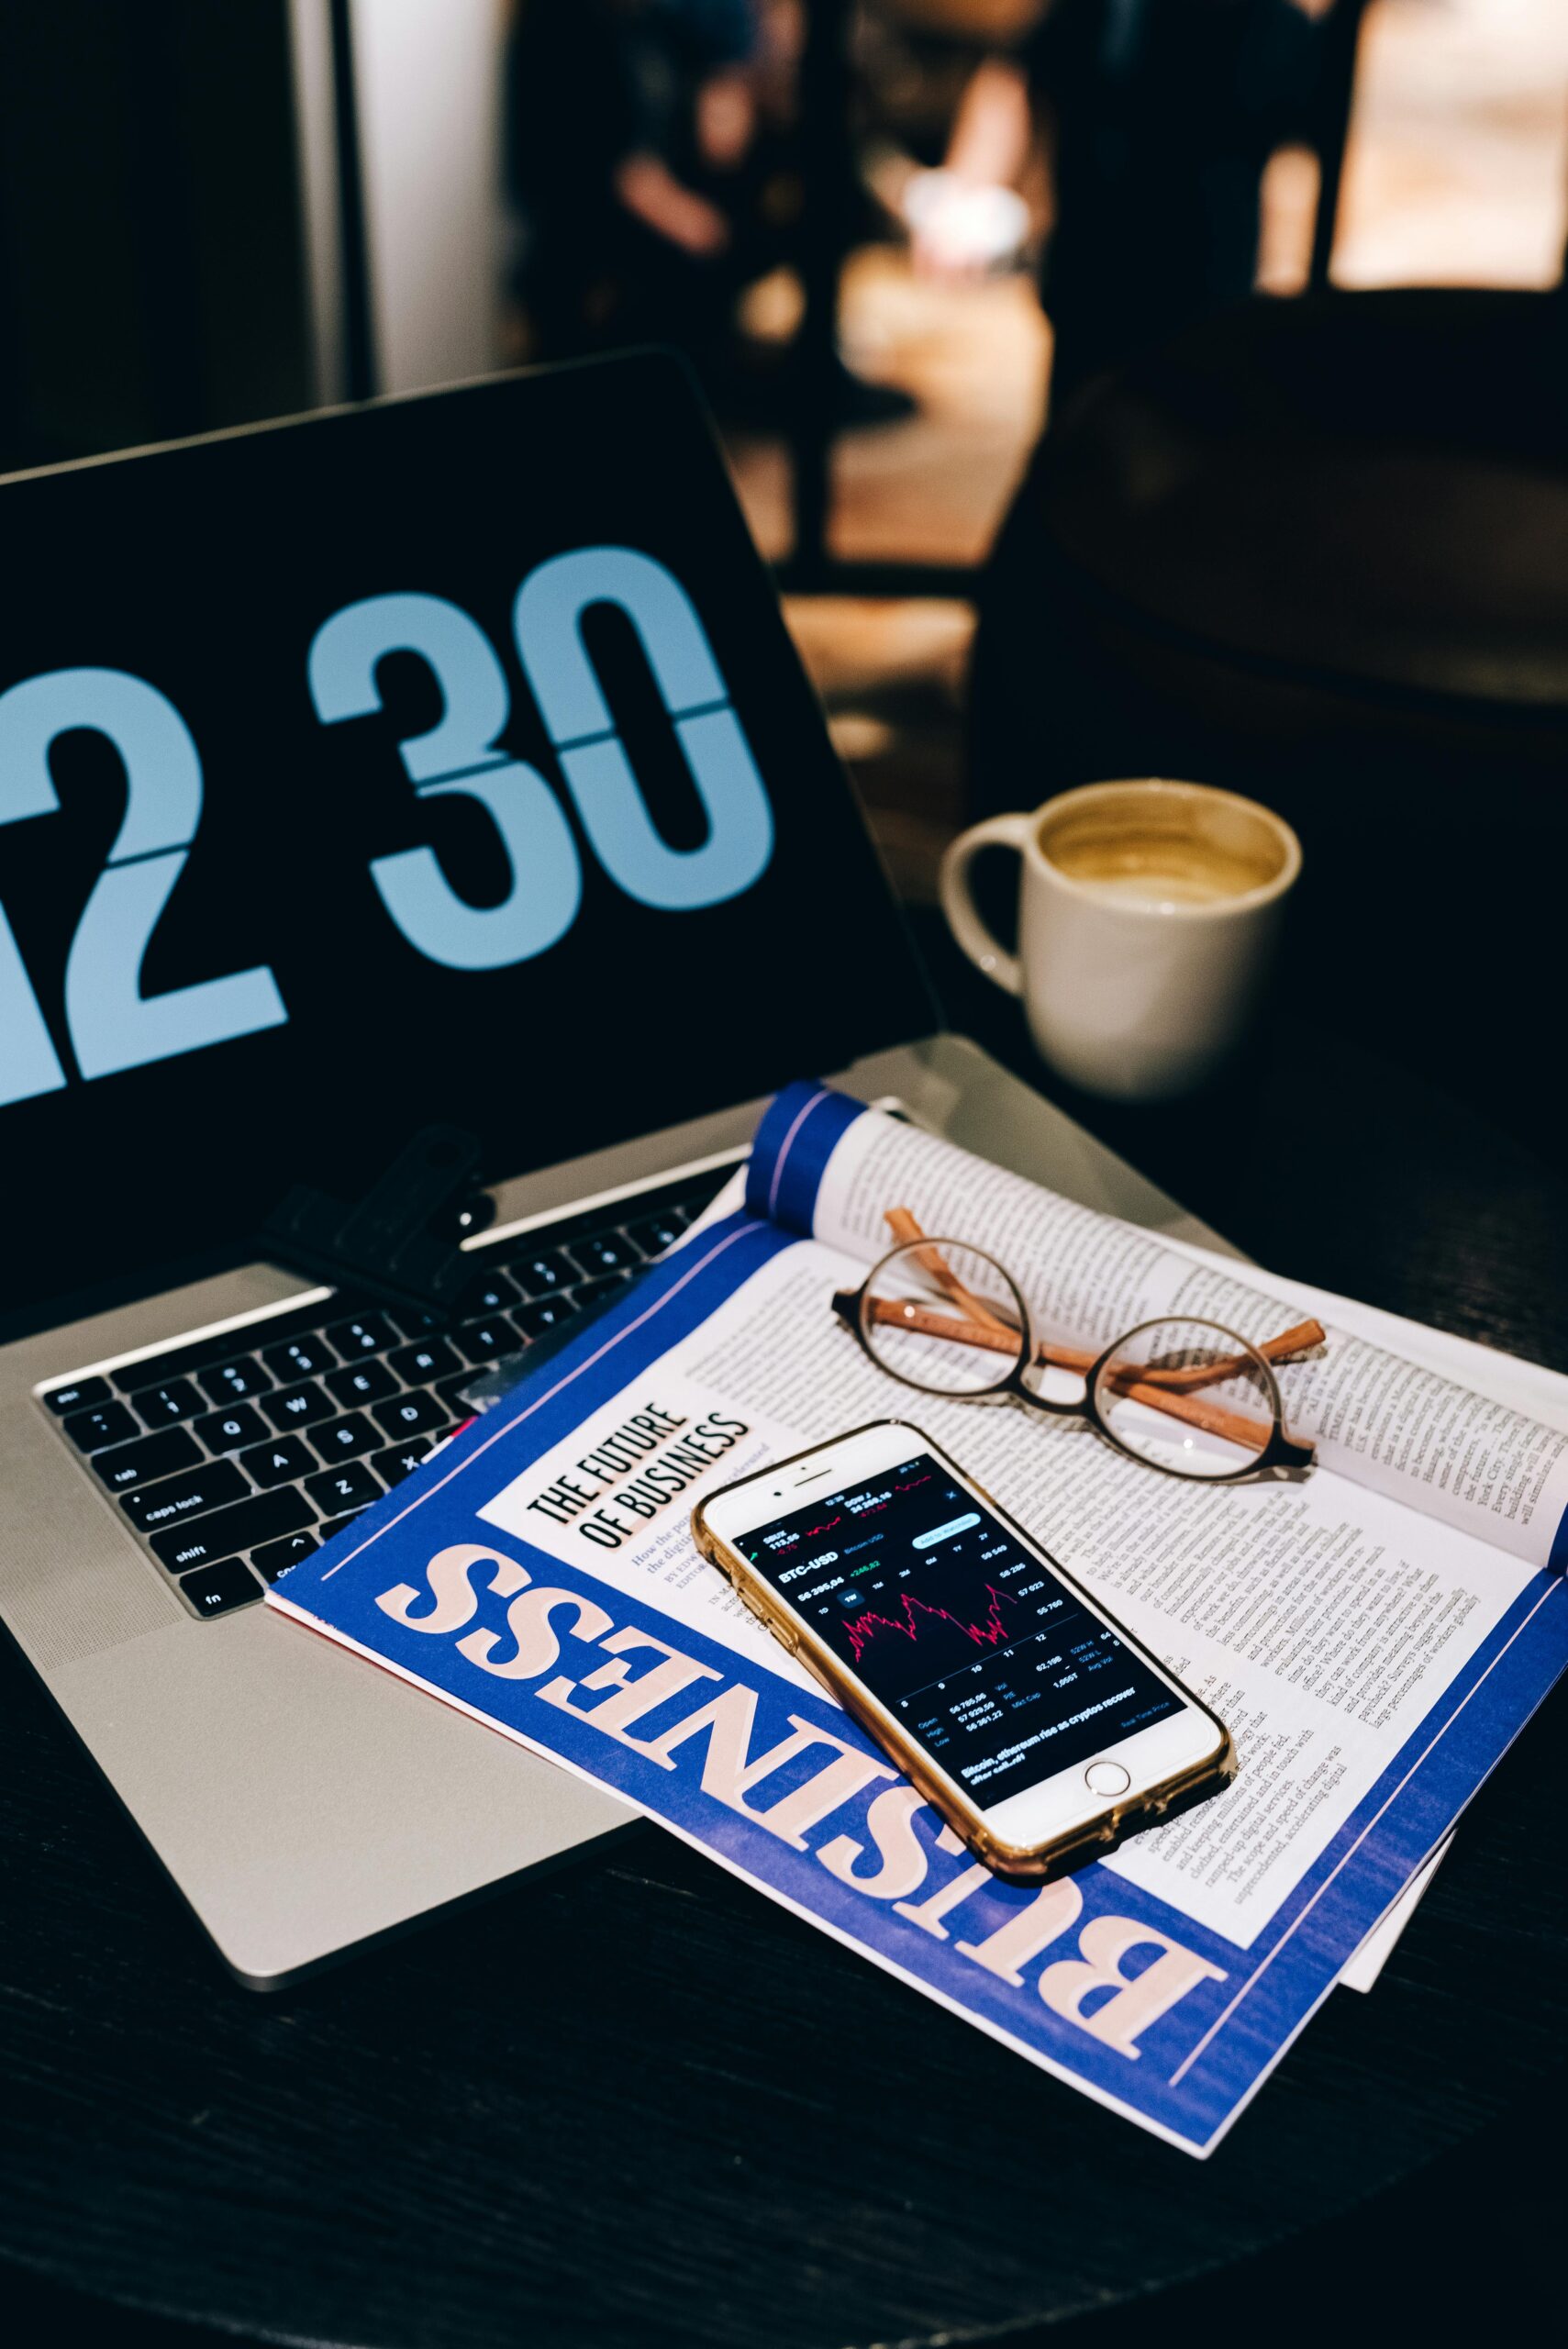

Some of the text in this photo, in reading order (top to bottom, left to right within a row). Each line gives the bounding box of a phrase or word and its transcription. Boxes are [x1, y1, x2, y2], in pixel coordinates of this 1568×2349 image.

[307, 545, 773, 970] 30
[354, 1376, 369, 1389] E
[286, 1397, 306, 1412] W
[401, 1408, 417, 1420] D
[224, 1421, 240, 1434] Q
[338, 1430, 353, 1443] S
[115, 1470, 137, 1481] tab
[273, 1454, 288, 1467] A
[402, 1455, 421, 1471] X
[527, 1475, 600, 1524] THE
[576, 1403, 687, 1485] FUTURE
[336, 1480, 352, 1494] Z
[579, 1508, 633, 1549] OF
[613, 1412, 749, 1520] BUSINESS
[1477, 1457, 1505, 1507] York City.
[1504, 1453, 1540, 1520] building will
[1521, 1460, 1554, 1525] will simulate
[146, 1496, 203, 1523] caps lock
[176, 1546, 206, 1562] shift
[631, 1547, 656, 1566] How
[655, 1531, 673, 1546] the
[647, 1558, 665, 1574] the
[663, 1551, 702, 1583] BY EDW
[778, 1552, 839, 1584] BTC-USD
[797, 1591, 812, 1601] 56
[810, 1576, 844, 1596] 395,04
[1344, 1592, 1443, 1714] and provides meaning beyond the
[1358, 1587, 1468, 1723] paycheck? Surveys suggest unusually
[1368, 1595, 1481, 1730] large percentages of workers globally
[1225, 1690, 1246, 1709] than
[917, 1718, 938, 1730] Open
[926, 1728, 944, 1738] High
[957, 1713, 968, 1723] 57
[934, 1737, 950, 1747] Low
[1026, 1692, 1041, 1702] Cap
[961, 1687, 1136, 1778] Bitcoin, ethereum rise as cryptos recover
[1229, 1709, 1249, 1732] ecord
[1250, 1711, 1268, 1729] that
[1247, 1732, 1271, 1755] work;
[970, 1770, 993, 1786] after
[375, 1543, 1229, 2060] BUSINESS
[1176, 1734, 1291, 1871] and keeping millions of people fed,
[1190, 1730, 1315, 1879] clothed, entertained and in touch with
[1226, 1745, 1341, 1883] The scope and speed of change was
[1149, 1821, 1174, 1853] speed;
[1162, 1798, 1216, 1862] enabled remote
[1205, 1779, 1296, 1887] ramped-up digital services.
[1234, 1763, 1348, 1905] unprecedented, accelerating digital
